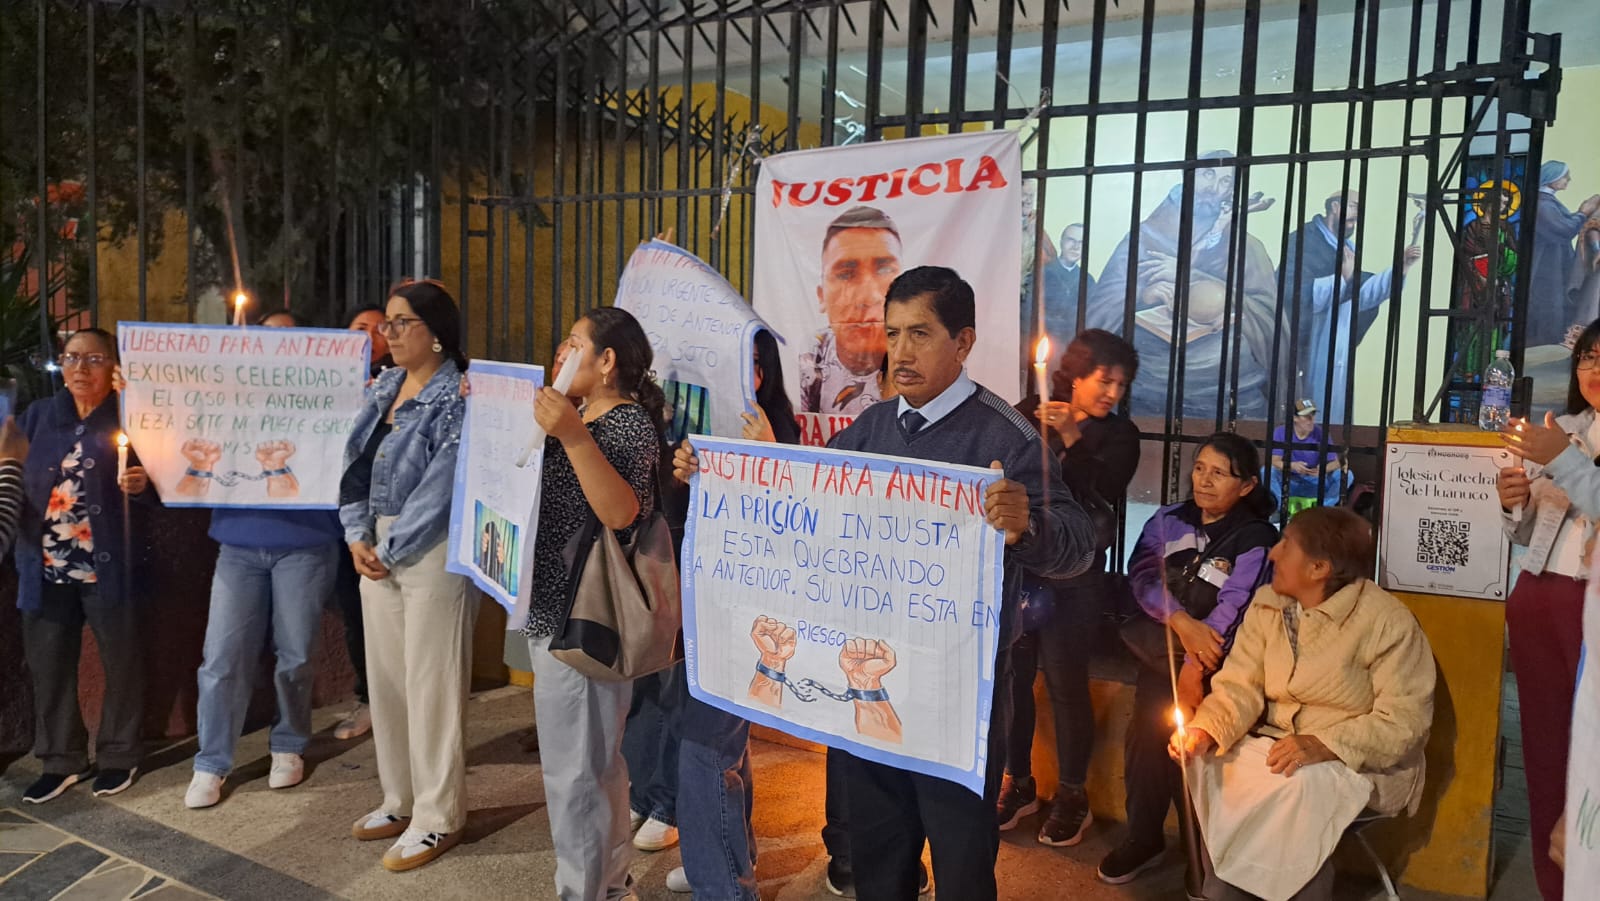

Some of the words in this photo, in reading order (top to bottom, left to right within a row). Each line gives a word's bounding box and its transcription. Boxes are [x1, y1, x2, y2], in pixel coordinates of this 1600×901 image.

[771, 155, 1007, 208] JUSTICIA
[657, 304, 678, 323] DE
[680, 311, 742, 340] ANTENOR
[220, 334, 264, 356] PARA
[671, 340, 718, 368] SOTO
[127, 361, 225, 384] EXIGIMOS
[153, 389, 175, 407] EL
[184, 391, 226, 408] CASO
[265, 393, 335, 410] ANTENOR
[699, 447, 794, 493] JUSTICIA
[811, 459, 873, 497] PARA
[885, 465, 989, 518] ANTENO
[1398, 467, 1438, 488] Iglesia
[1439, 469, 1499, 486] Catedral
[1405, 484, 1424, 496] de
[703, 490, 730, 520] LA
[839, 512, 960, 549] INJUSTA
[723, 529, 776, 559] ESTA
[793, 539, 945, 587] QUEBRANDO
[693, 555, 704, 575] A
[805, 574, 833, 604] SU
[840, 581, 894, 614] VIDA
[908, 593, 958, 625] ESTA
[971, 600, 999, 629] EN
[796, 620, 847, 648] RIESGO
